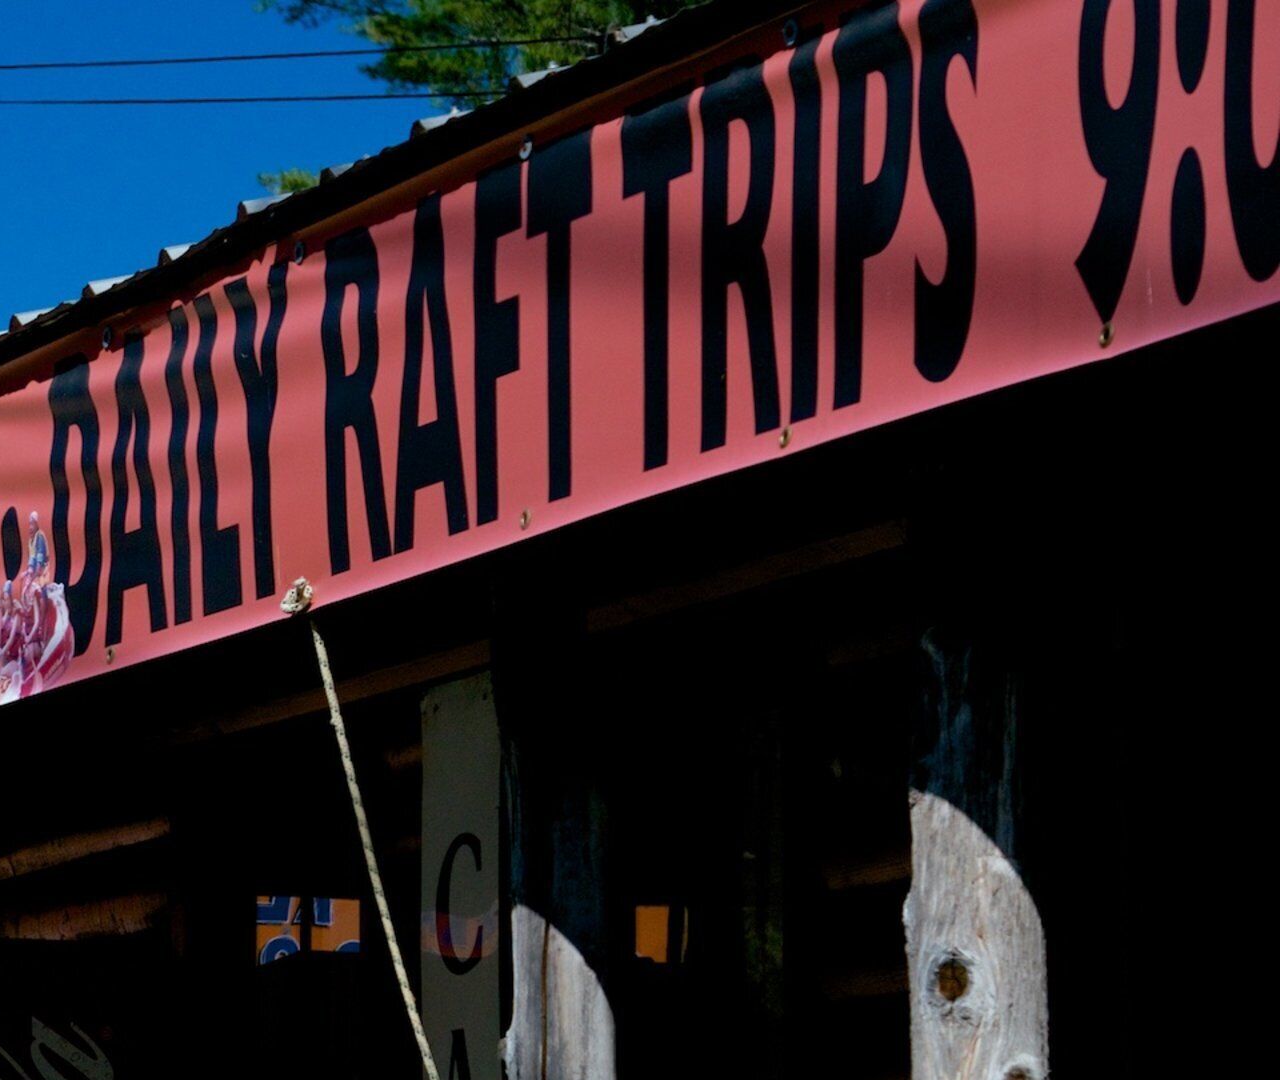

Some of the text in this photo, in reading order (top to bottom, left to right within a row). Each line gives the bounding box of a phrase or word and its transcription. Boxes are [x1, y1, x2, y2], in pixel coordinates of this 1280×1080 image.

[46, 252, 288, 660] DAILY
[321, 130, 596, 575] RAFT
[622, 5, 980, 474] TRIPS
